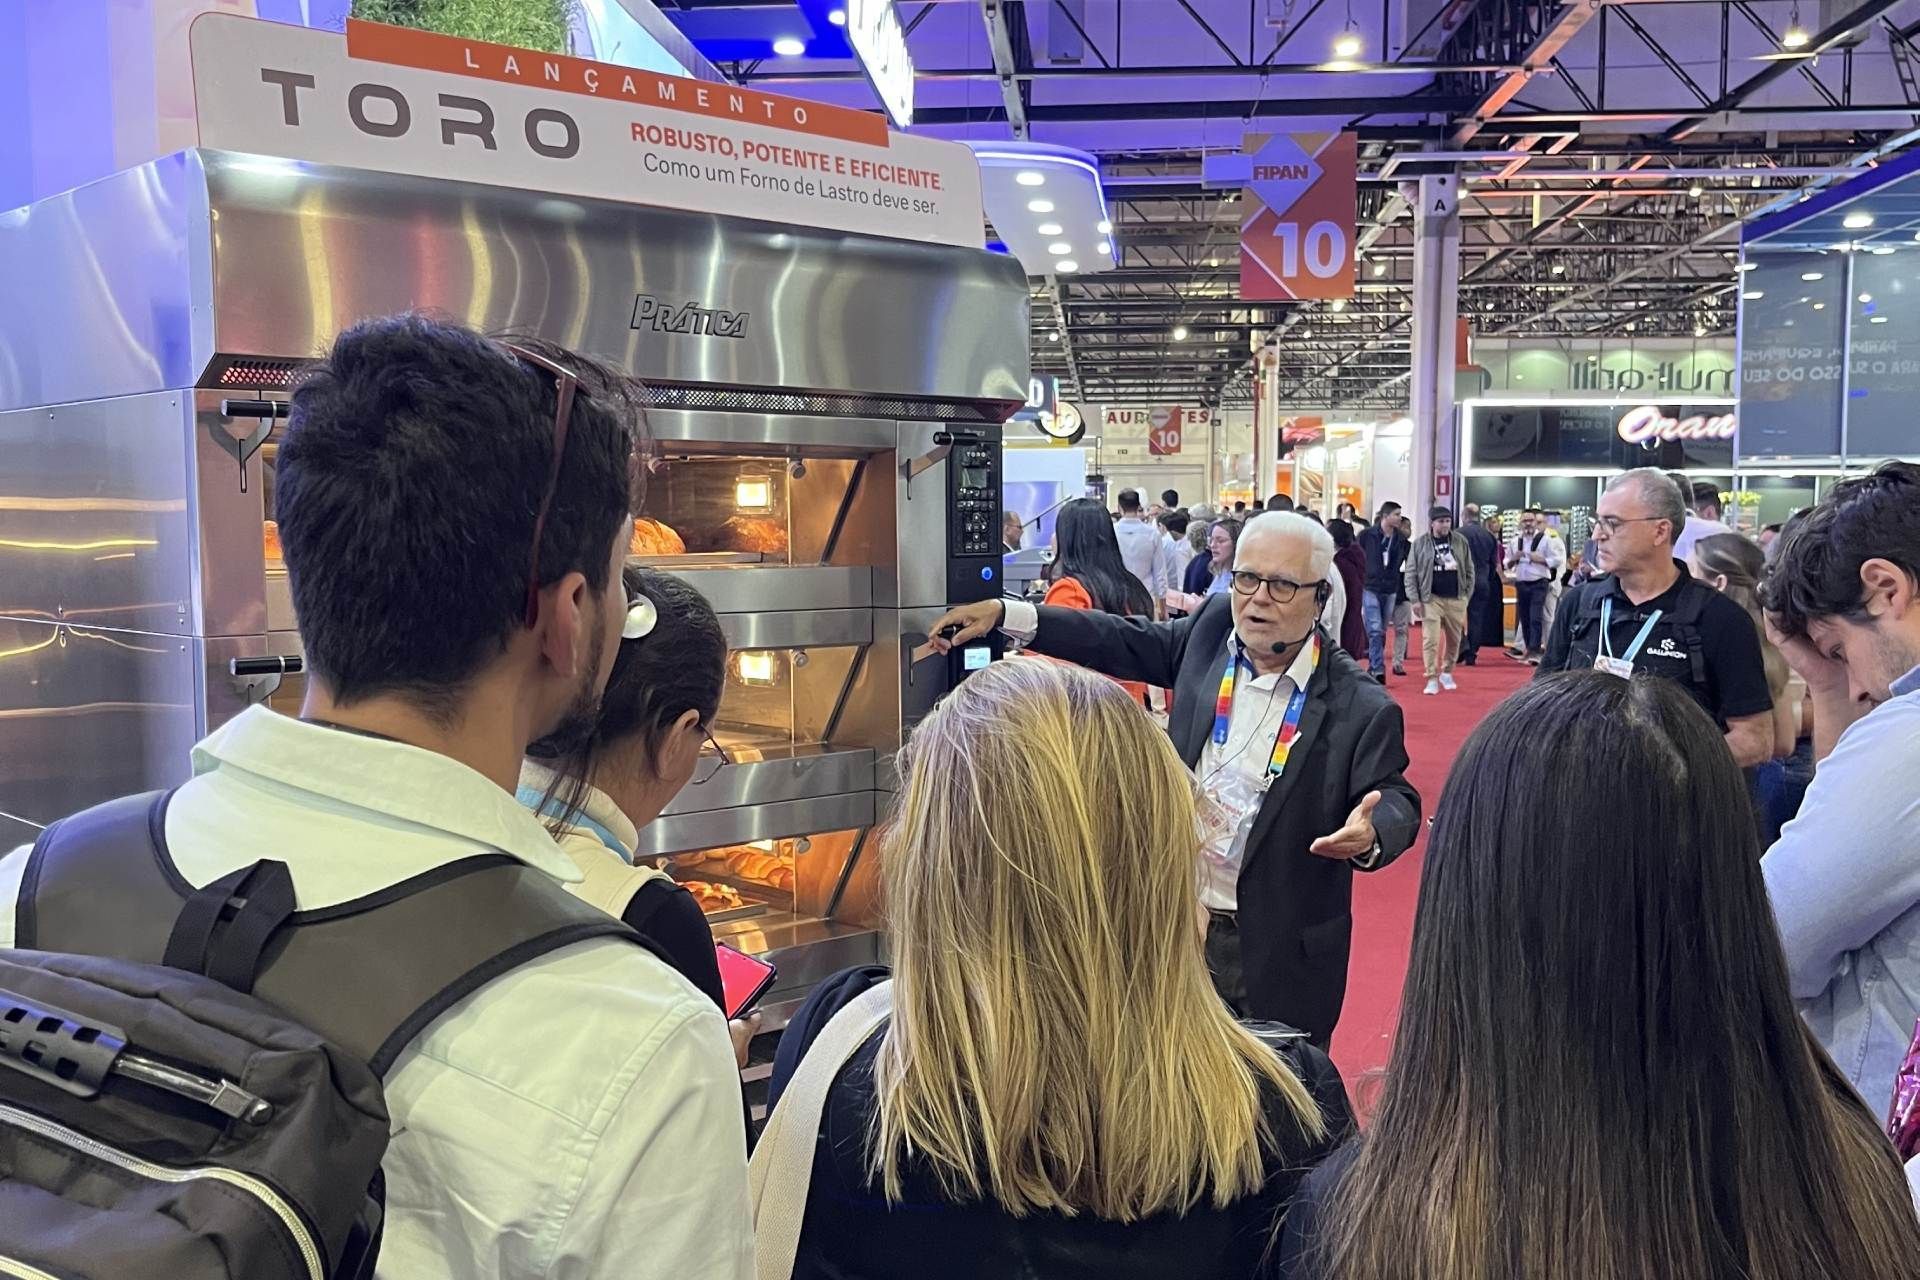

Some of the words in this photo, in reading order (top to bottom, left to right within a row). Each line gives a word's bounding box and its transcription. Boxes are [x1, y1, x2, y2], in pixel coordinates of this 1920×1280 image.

[260, 67, 581, 160] TORO
[464, 47, 808, 125] LANÇAMENTO
[630, 122, 739, 161] ROBUSTO,
[743, 140, 831, 173] POTENTE
[835, 156, 847, 175] E
[851, 159, 945, 191] EFICIENTE.
[643, 152, 700, 180] Como
[705, 166, 735, 185] um
[741, 167, 790, 192] Forno
[794, 175, 815, 196] de
[819, 179, 870, 204] Lastro
[872, 188, 910, 211] deve
[912, 198, 940, 215] ser.
[1252, 164, 1309, 181] FIPAN
[1433, 199, 1446, 212] A
[1272, 220, 1347, 279] 10
[1158, 430, 1180, 448] 10
